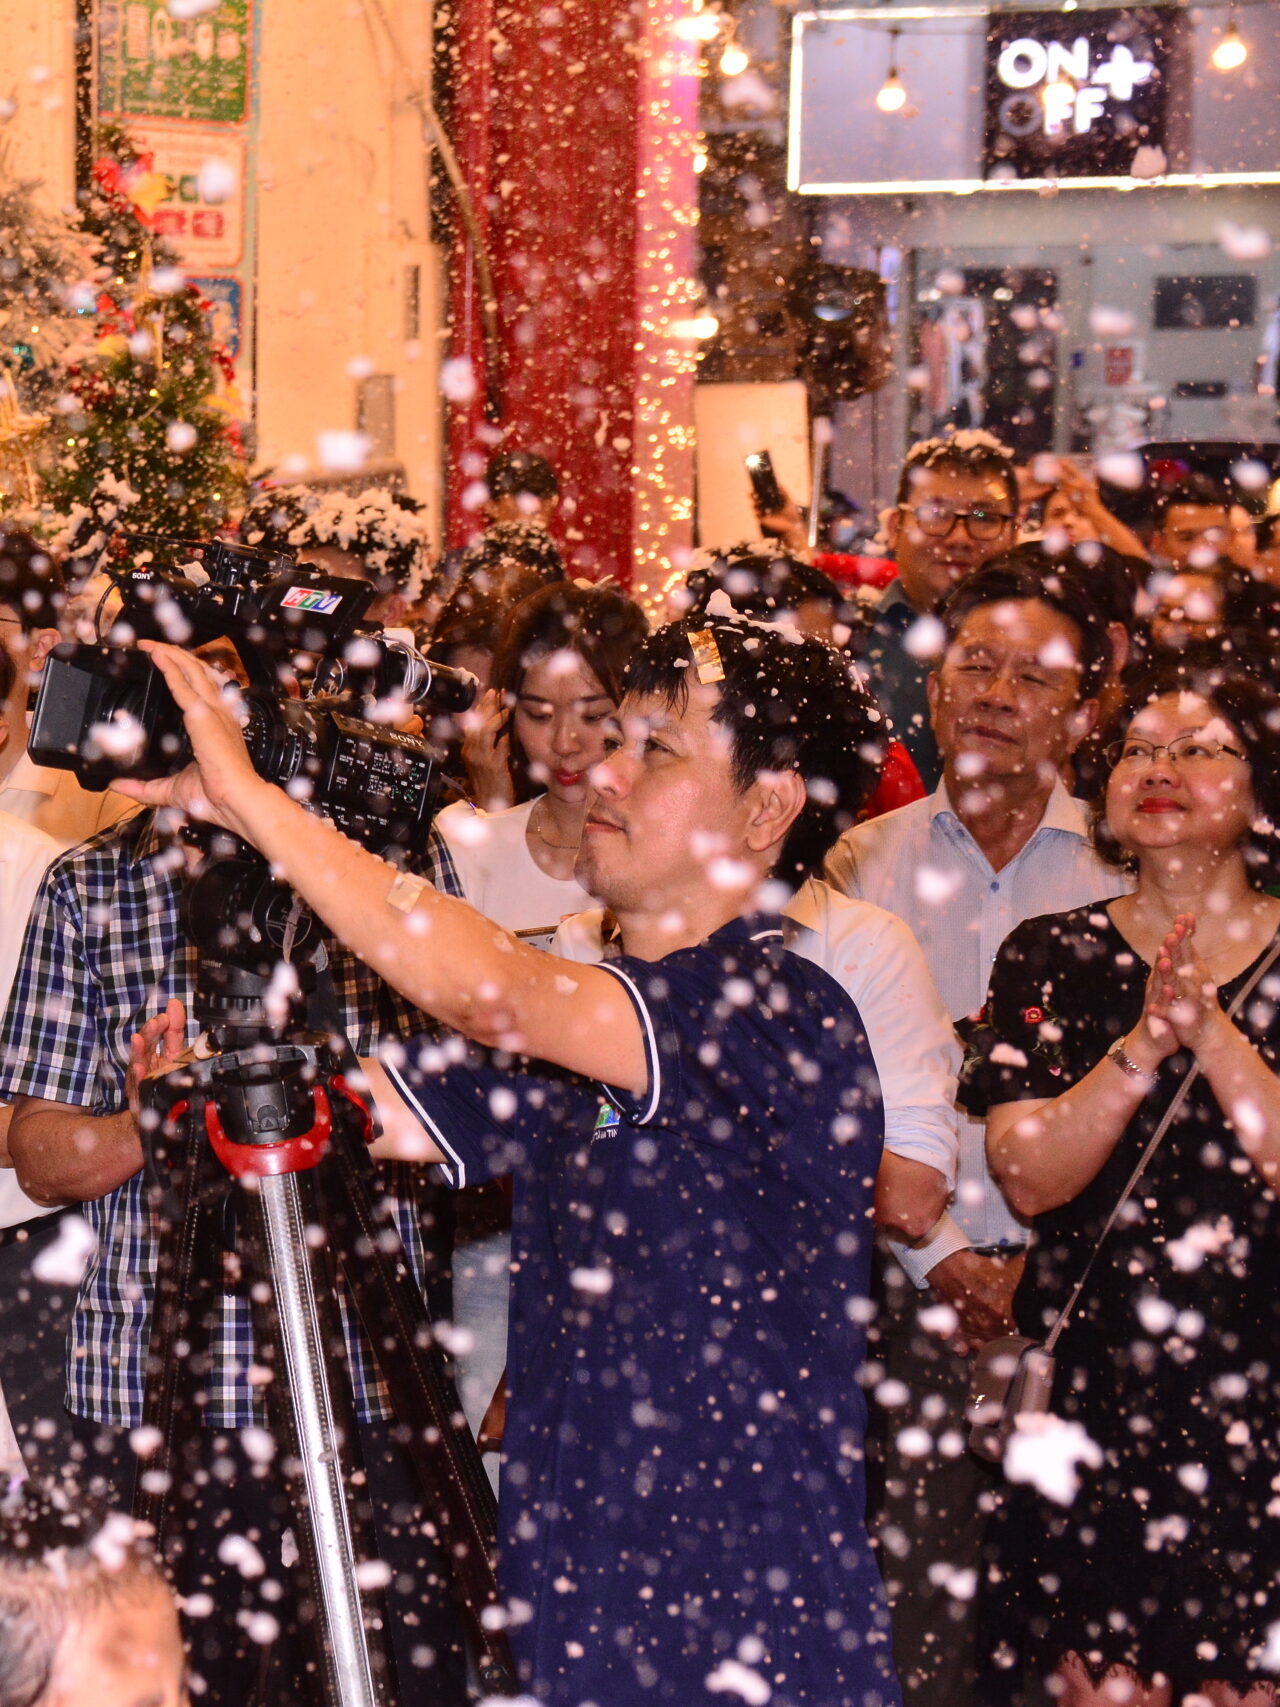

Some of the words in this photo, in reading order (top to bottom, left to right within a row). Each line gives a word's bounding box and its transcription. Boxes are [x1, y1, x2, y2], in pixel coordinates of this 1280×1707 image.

[997, 37, 1089, 89] ON
[131, 572, 151, 580] SONY
[282, 589, 338, 612] HTV
[389, 732, 425, 750] SONY
